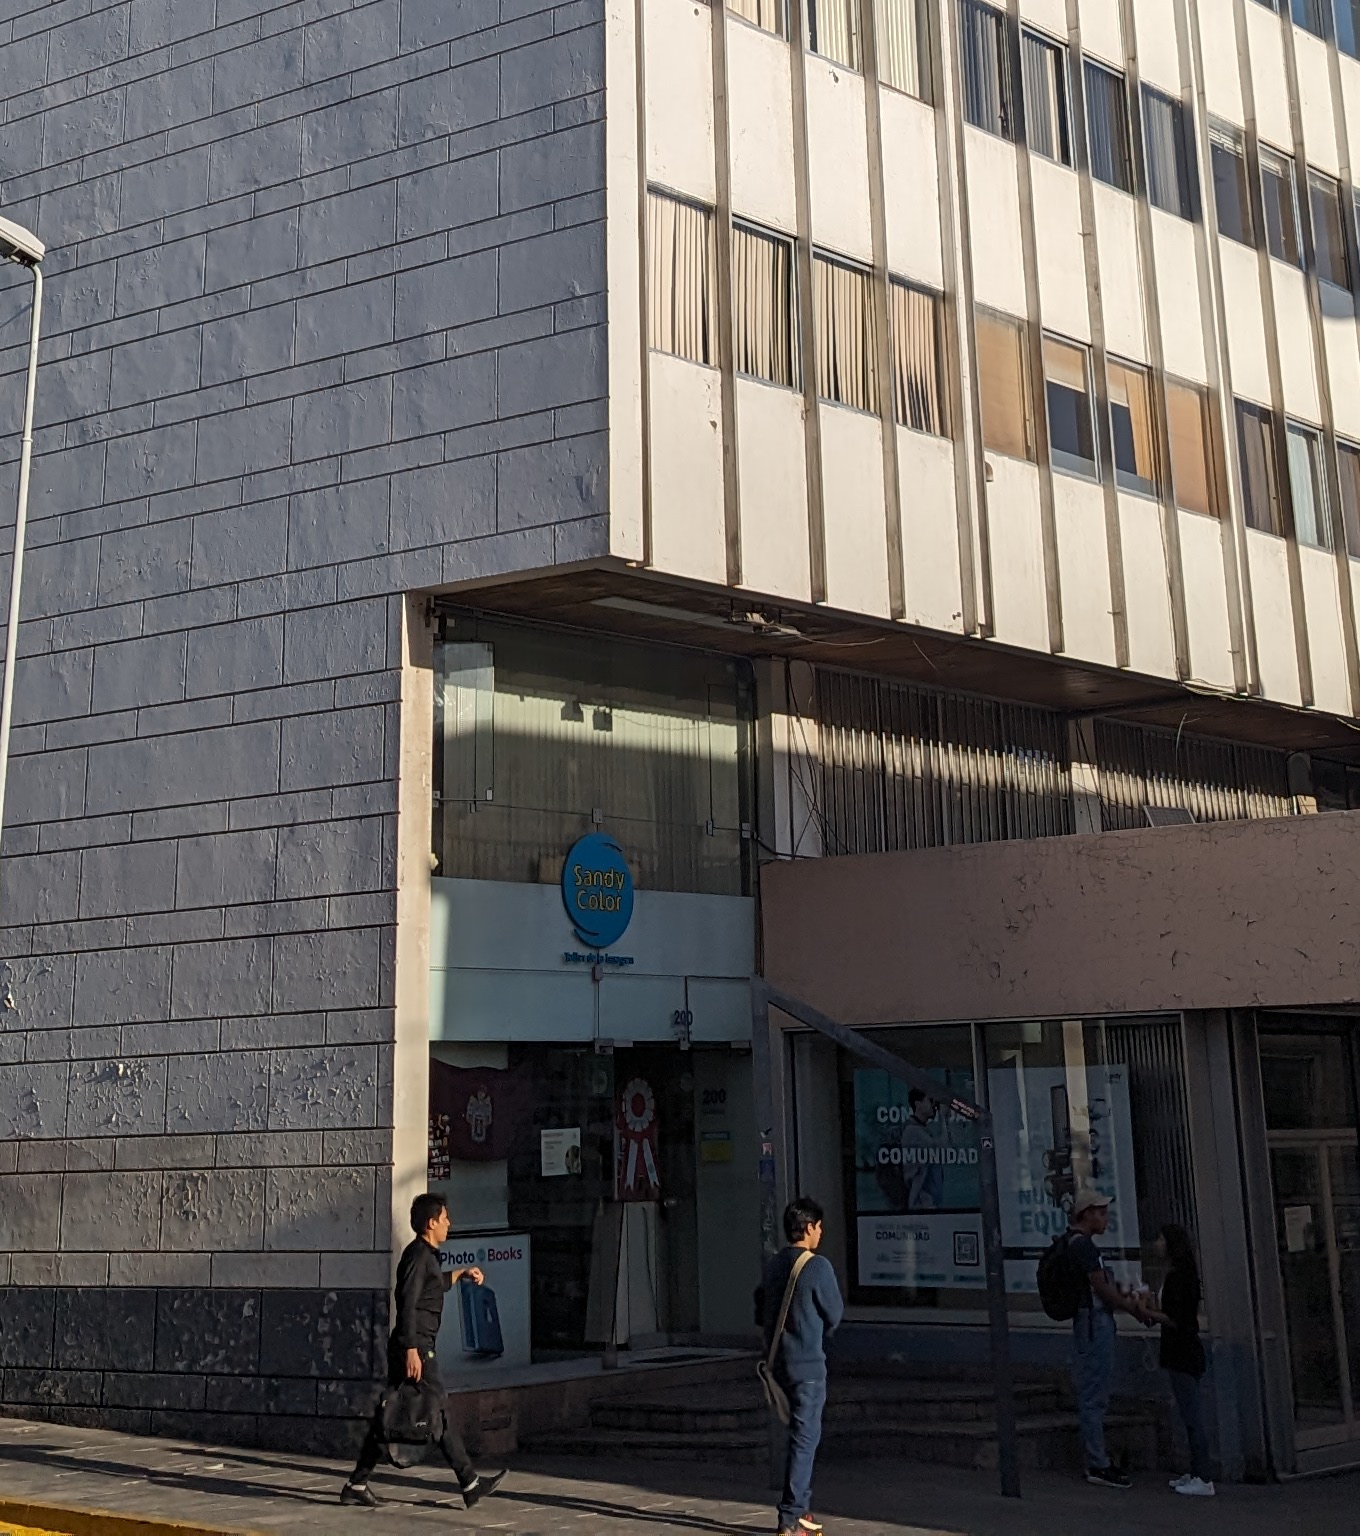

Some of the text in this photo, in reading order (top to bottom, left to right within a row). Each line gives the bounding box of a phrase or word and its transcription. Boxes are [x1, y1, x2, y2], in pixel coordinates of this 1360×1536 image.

[573, 864, 625, 892] Sandy
[576, 890, 622, 911] Color
[674, 1010, 693, 1026] 200
[703, 1089, 727, 1104] 200
[878, 1147, 978, 1165] COMUNIDAD
[1020, 1210, 1118, 1235] EQUS
[440, 1246, 522, 1265] Photo Books
